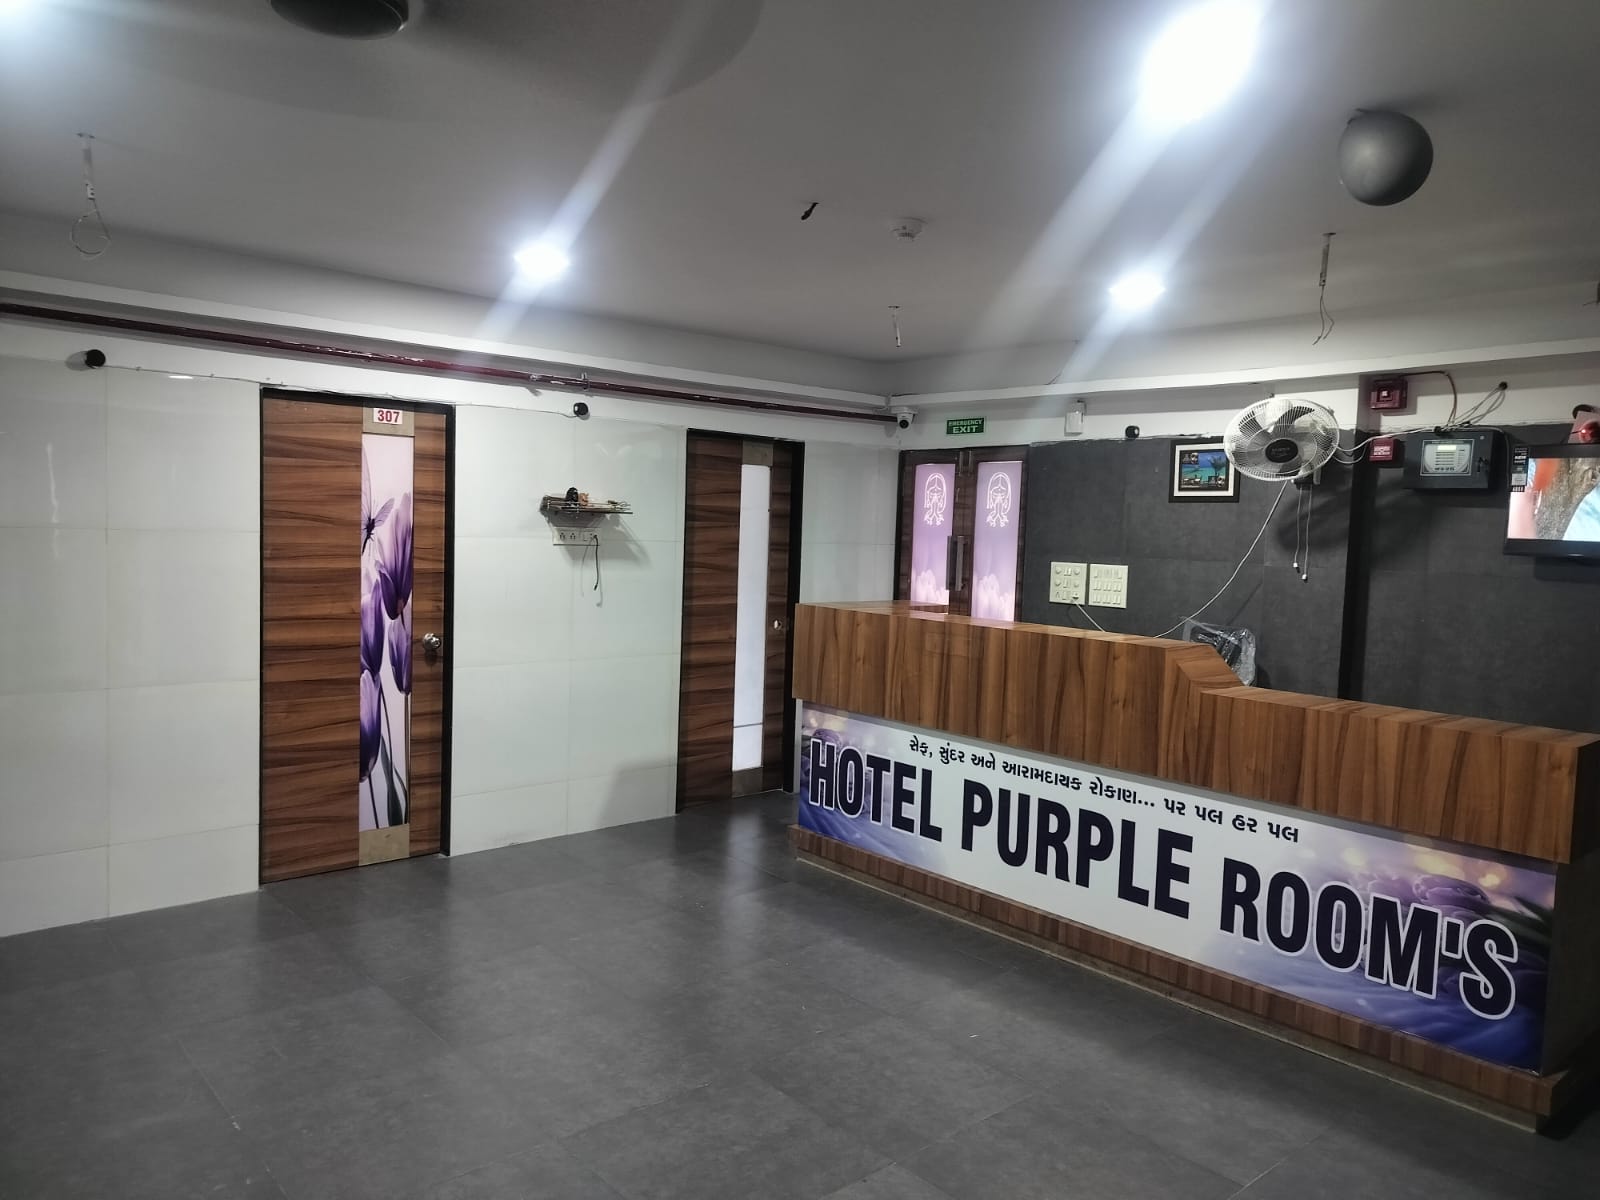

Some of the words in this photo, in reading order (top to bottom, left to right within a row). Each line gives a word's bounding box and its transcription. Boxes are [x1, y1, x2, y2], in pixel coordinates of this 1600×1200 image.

[378, 410, 400, 423] 307
[952, 425, 978, 433] EXIT
[909, 735, 933, 758] સેફ,
[939, 742, 965, 764] સુંદર
[971, 751, 996, 771] અને
[1002, 760, 1082, 791] આરામદાયક
[1195, 803, 1224, 825] પલ
[1232, 814, 1258, 834] હર
[1267, 822, 1299, 843] પલ
[808, 738, 944, 843] HOTEL
[961, 779, 1194, 919] PURPLE
[1220, 857, 1519, 1021] ROOM'S
